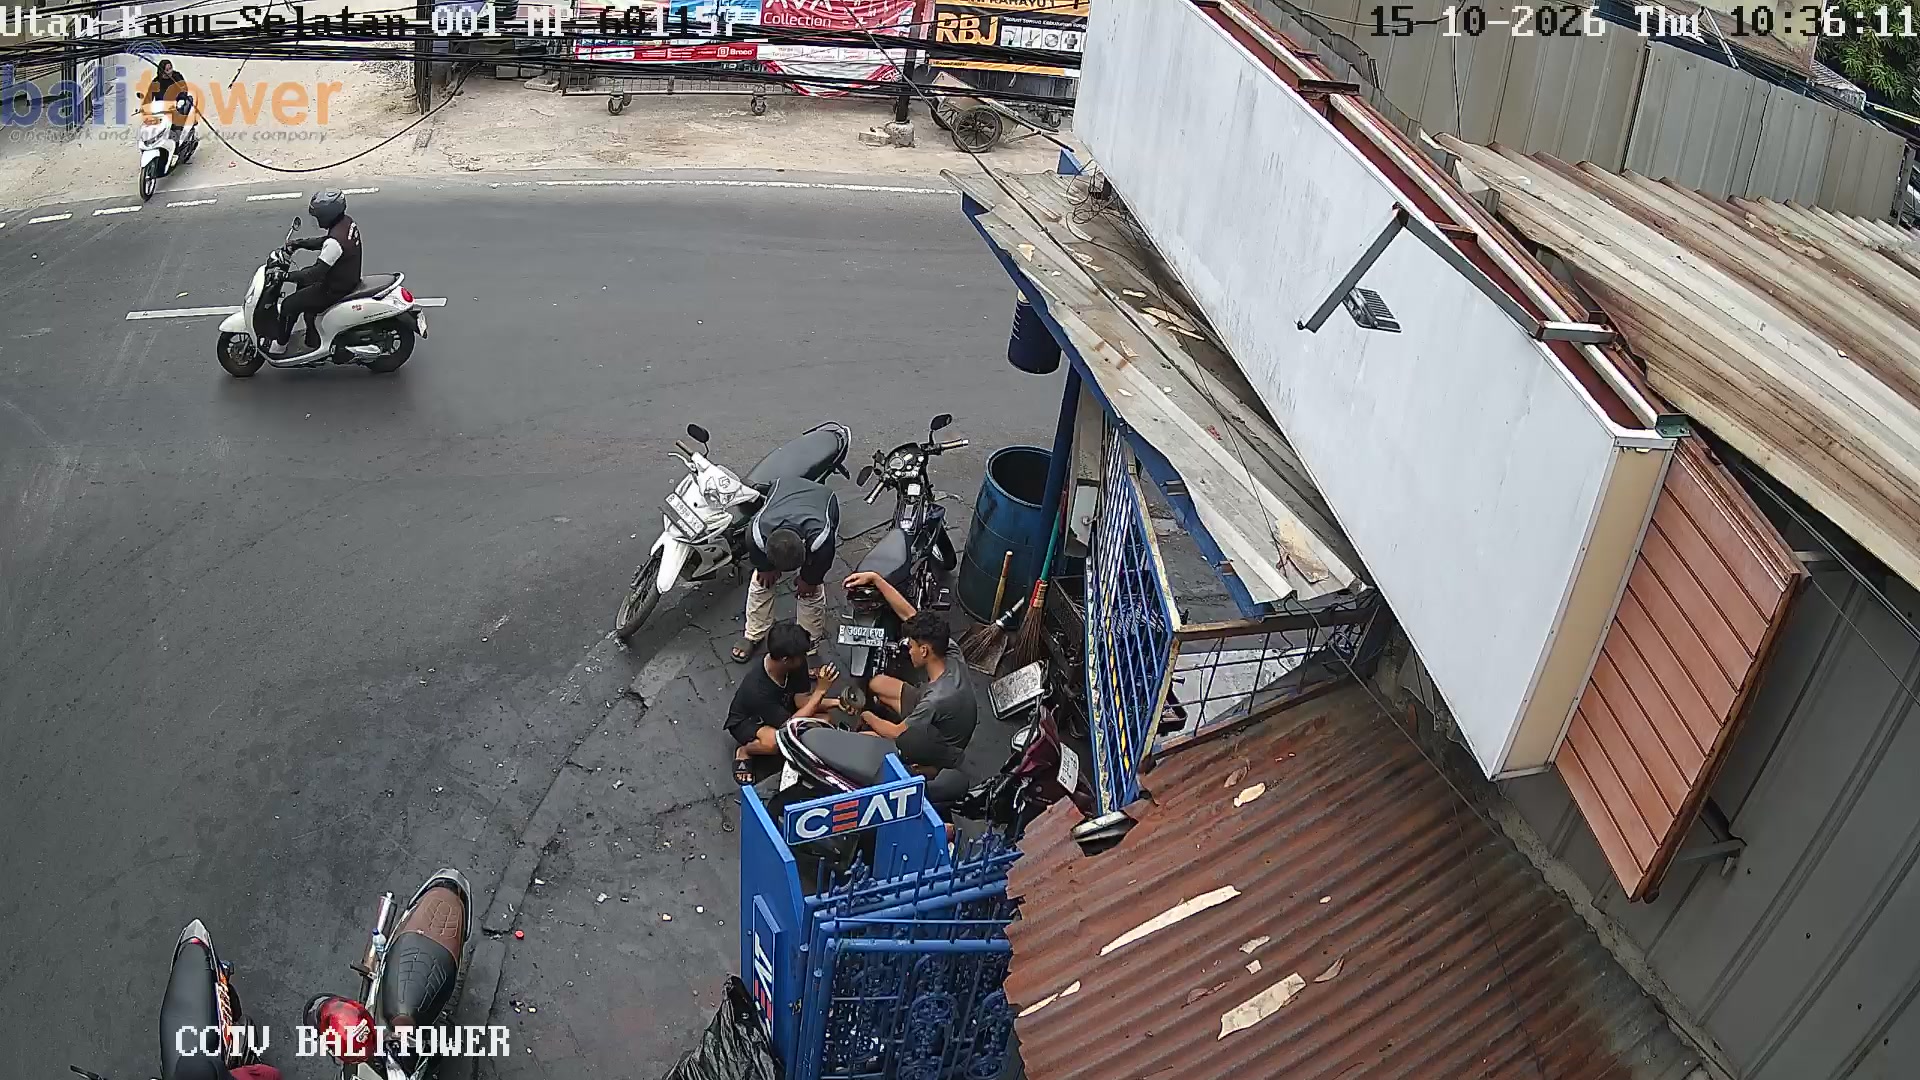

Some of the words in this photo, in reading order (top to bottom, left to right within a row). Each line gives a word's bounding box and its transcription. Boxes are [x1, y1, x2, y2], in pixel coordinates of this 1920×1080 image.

[763, 12, 832, 28] Collection
[935, 12, 998, 46] RBJ
[795, 786, 917, 840] CEAT
